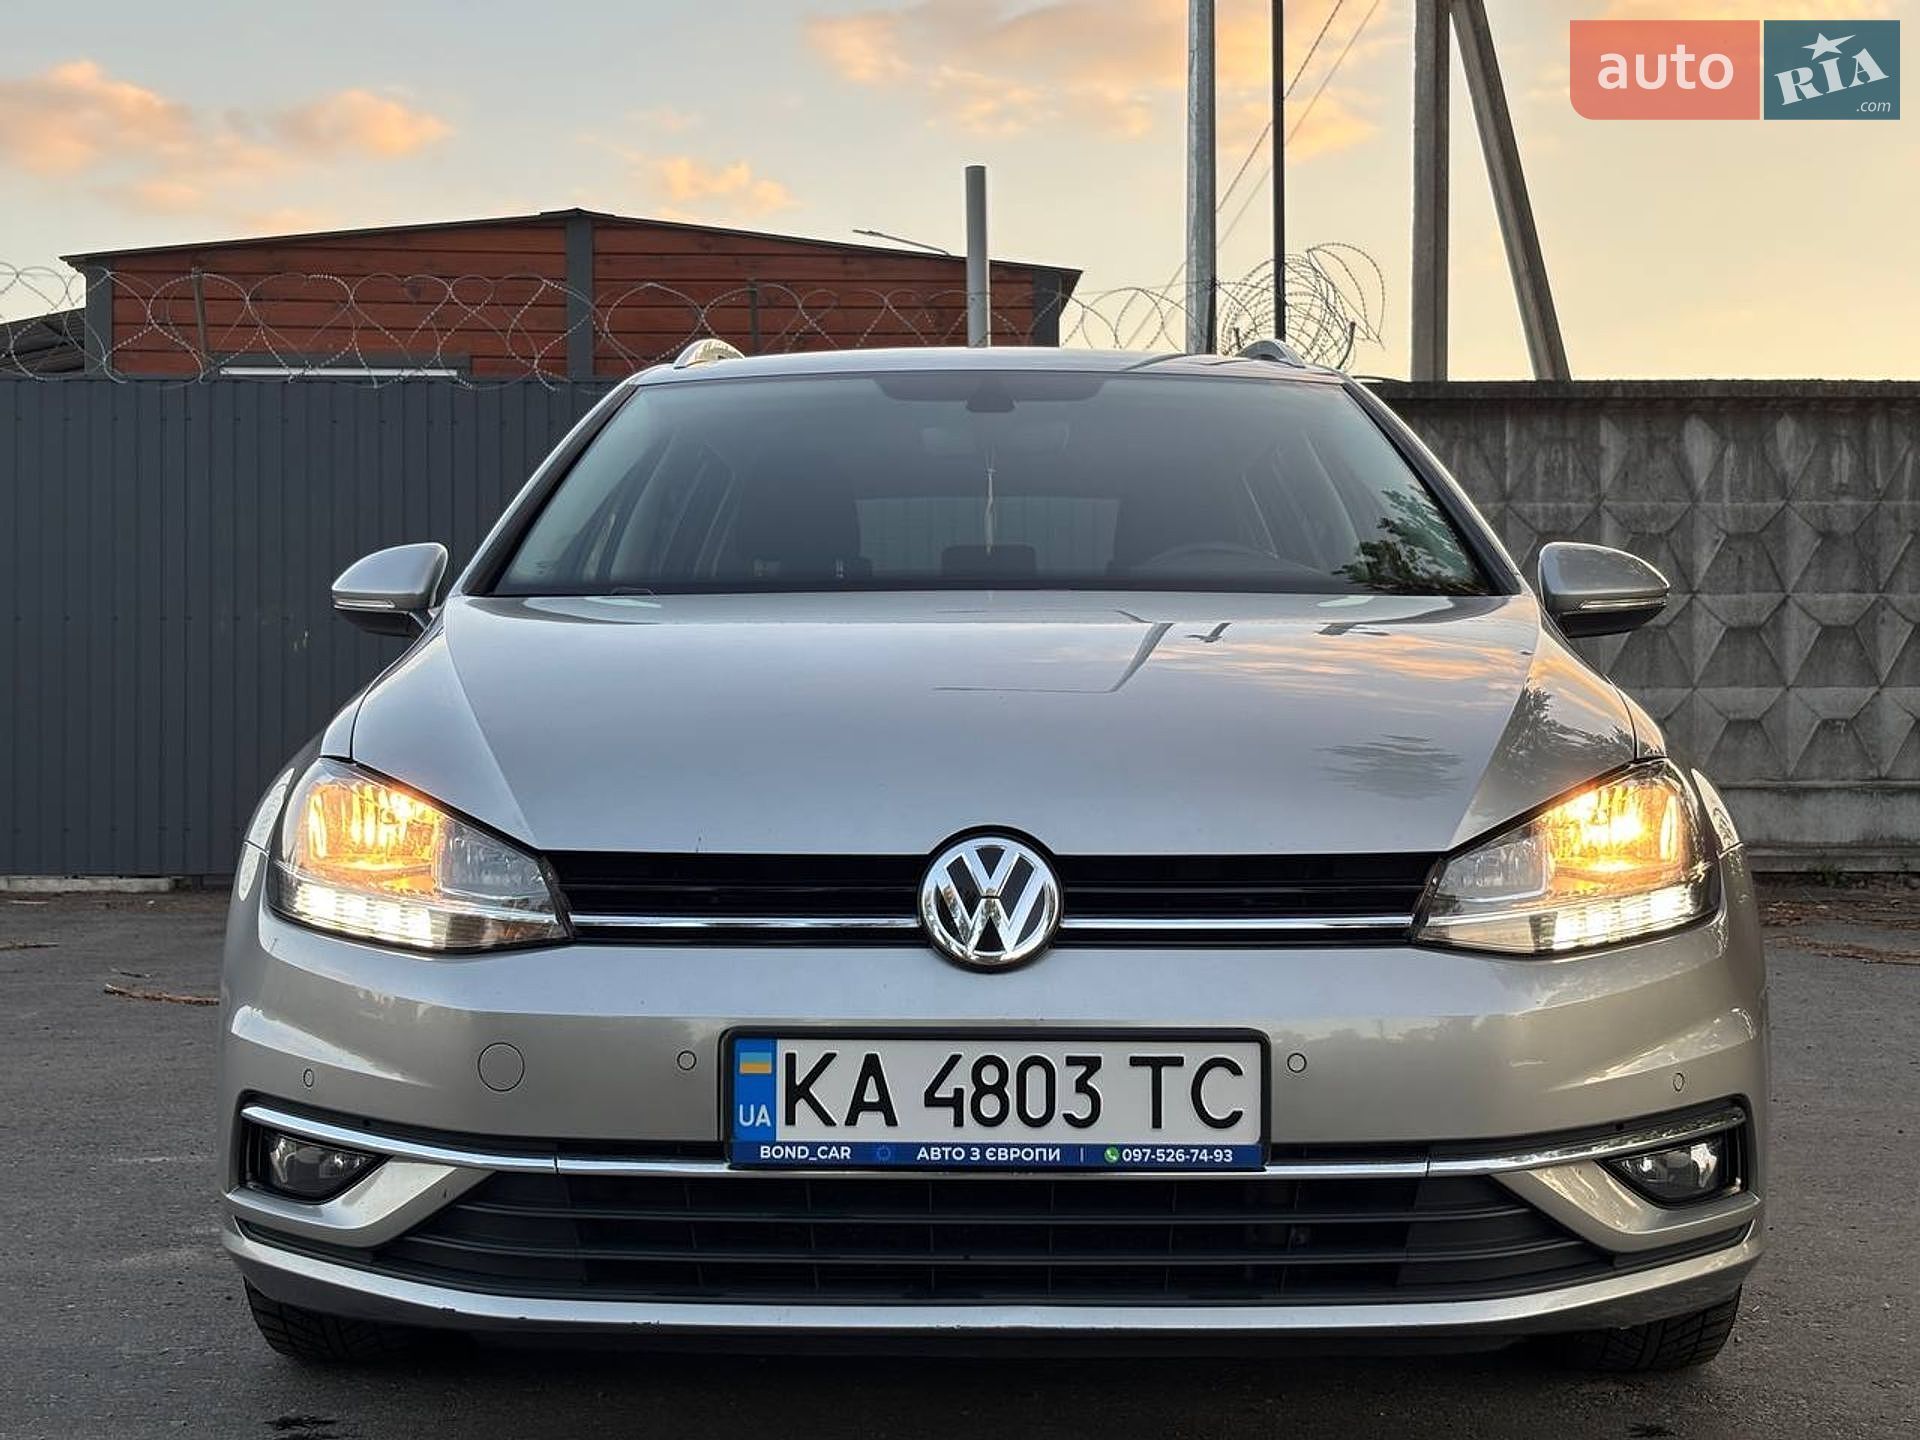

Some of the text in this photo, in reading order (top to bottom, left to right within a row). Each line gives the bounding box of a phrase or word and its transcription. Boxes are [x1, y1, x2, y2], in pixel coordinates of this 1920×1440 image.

[784, 1052, 1244, 1130] KA 4803 TC
[738, 1104, 771, 1127] UA
[760, 1146, 851, 1162] BOND_CAR
[917, 1147, 964, 1162] АВТО
[986, 1147, 1061, 1162] ЄВРОПИ
[1122, 1149, 1234, 1163] 097-526-74-93
